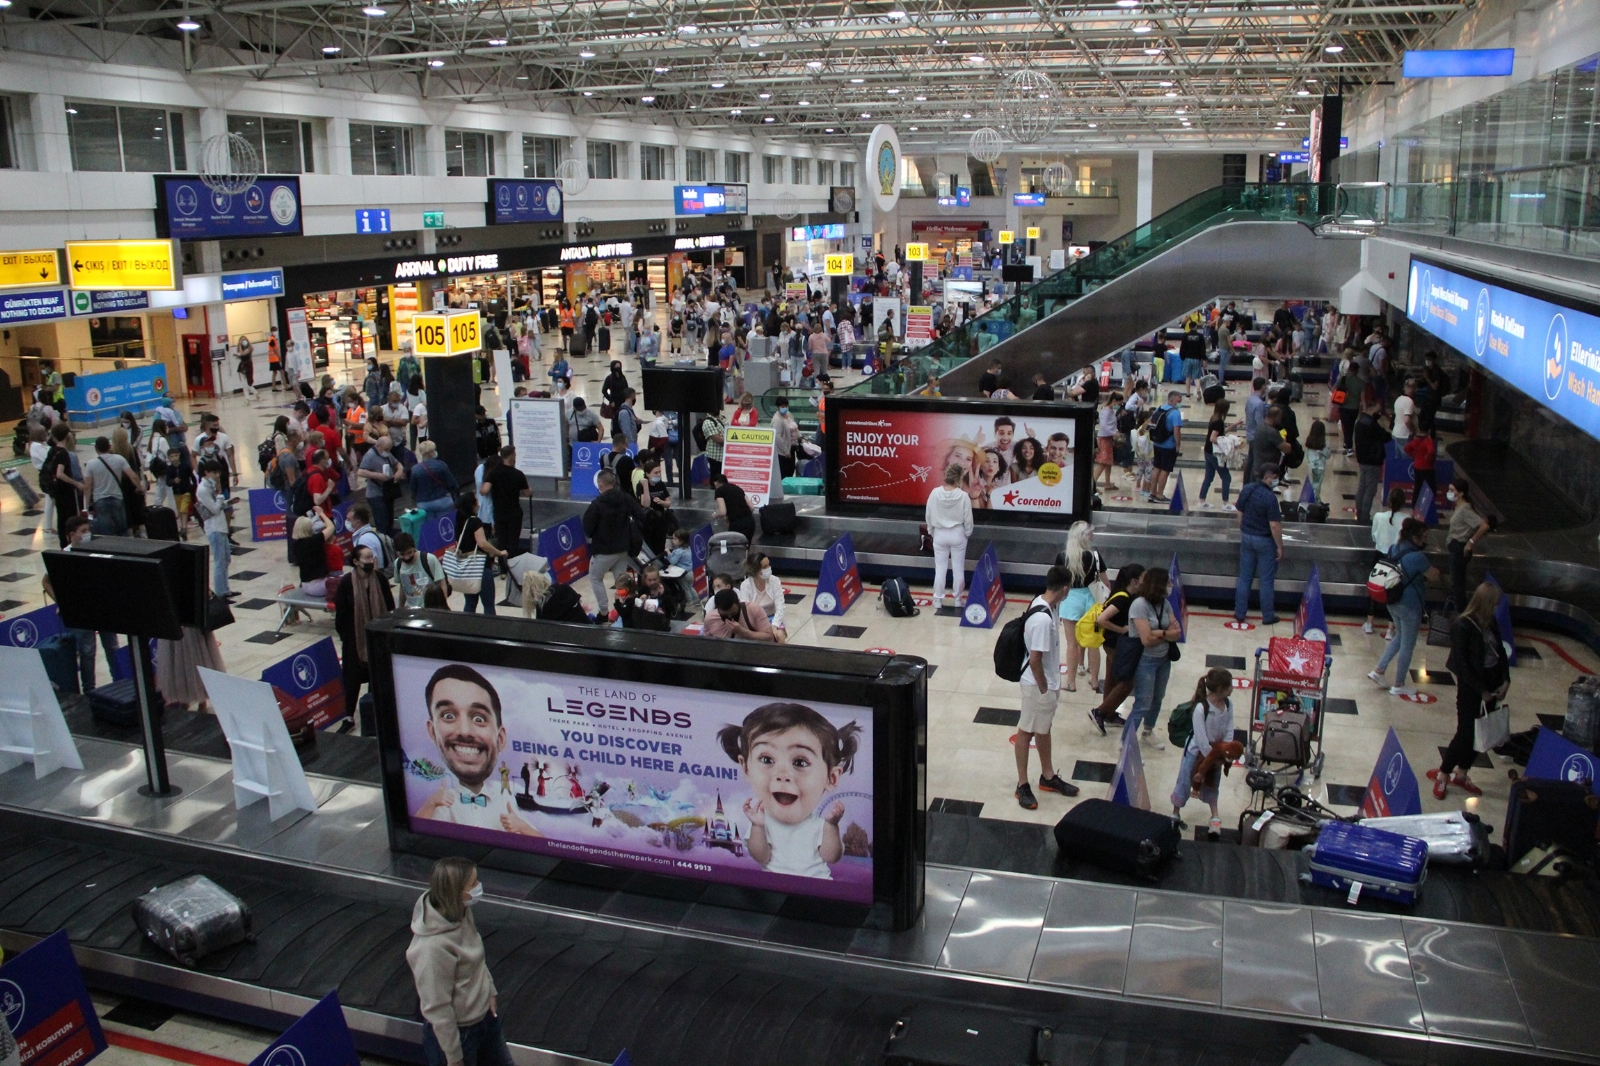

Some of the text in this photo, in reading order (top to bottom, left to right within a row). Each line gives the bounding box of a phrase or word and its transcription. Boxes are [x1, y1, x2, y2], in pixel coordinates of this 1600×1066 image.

[675, 235, 725, 249] ARRIVAL DUTY FREE
[560, 243, 632, 261] ANTALYA DUTY FREE
[908, 248, 921, 256] 103
[3, 256, 17, 265] EXIT
[24, 255, 54, 264] ВЫХОД
[86, 261, 105, 273] ÇIKIŞ
[112, 260, 127, 270] EXIT
[135, 260, 168, 271] ВЫХОД
[396, 254, 498, 278] ARRIVAL DUTY FREE
[827, 260, 842, 270] 104
[42, 296, 59, 306] MUAF
[93, 298, 148, 309] NOTHING TO DECLARE
[0, 305, 65, 319] NOTHING TO DECLARE
[416, 325, 445, 345] 105
[453, 321, 476, 344] 105
[1568, 370, 1586, 398] Wash
[846, 432, 919, 445] ENJOY YOUR
[846, 445, 899, 458] HOLIDAY.
[1017, 497, 1062, 507] corendon
[578, 686, 657, 703] THE LAND OF
[547, 697, 692, 729] LEGENDS
[628, 727, 663, 736] SHOPPING
[560, 729, 682, 756] YOU DISCOVER
[512, 740, 738, 780] BEING A CHILD HERE AGAIN!
[547, 840, 670, 865] thelandoflegendsthemepark.com
[676, 861, 692, 869] 444
[694, 863, 712, 872] 9913
[36, 1021, 73, 1052] KORUYUN
